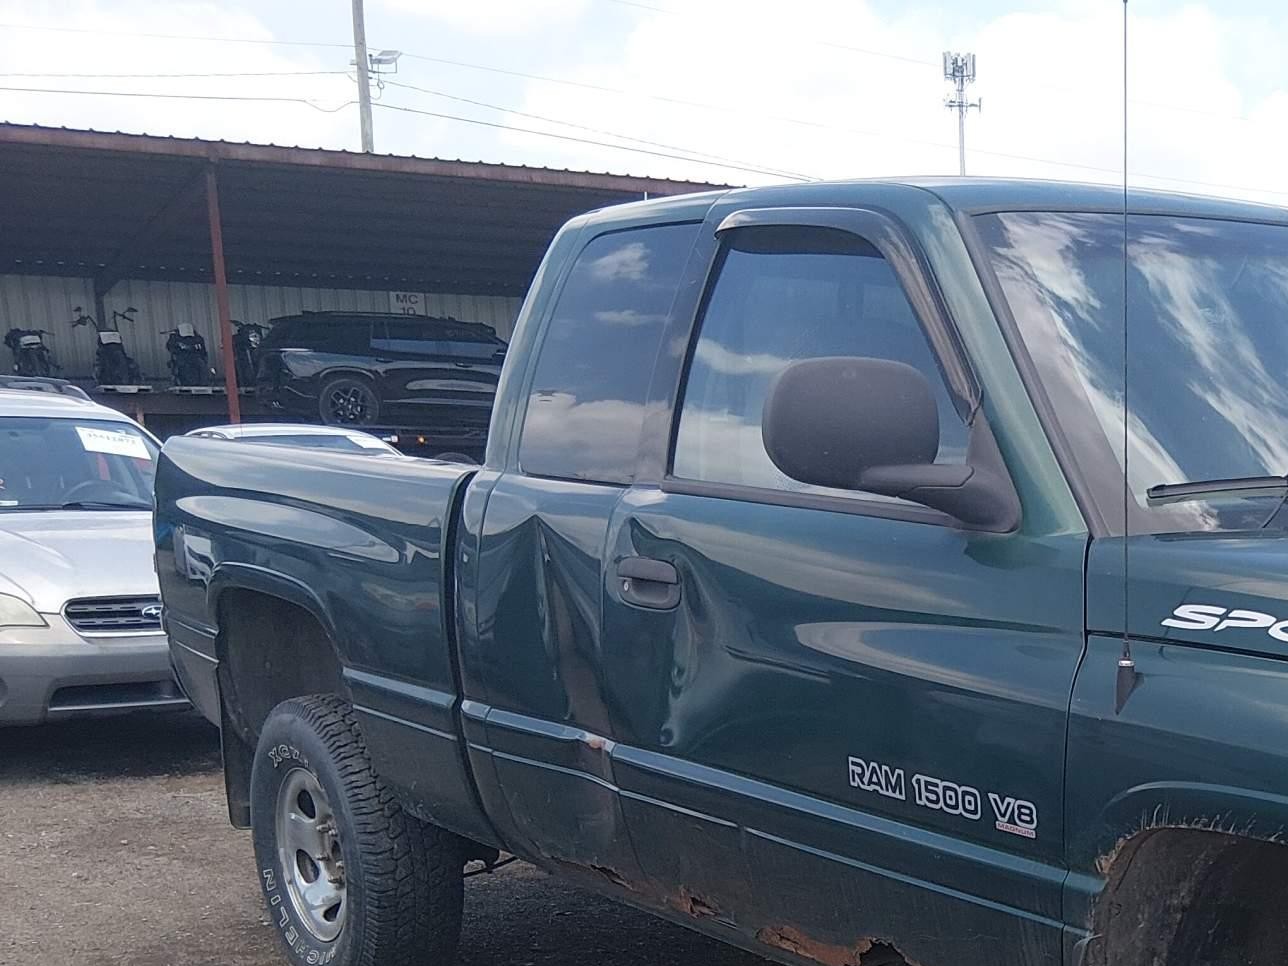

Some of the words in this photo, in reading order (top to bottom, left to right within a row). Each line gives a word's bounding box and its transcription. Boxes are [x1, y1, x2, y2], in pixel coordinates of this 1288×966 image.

[396, 294, 418, 304] MC
[848, 755, 906, 801] RAM
[911, 773, 982, 821] 1500
[988, 792, 1038, 830] V8
